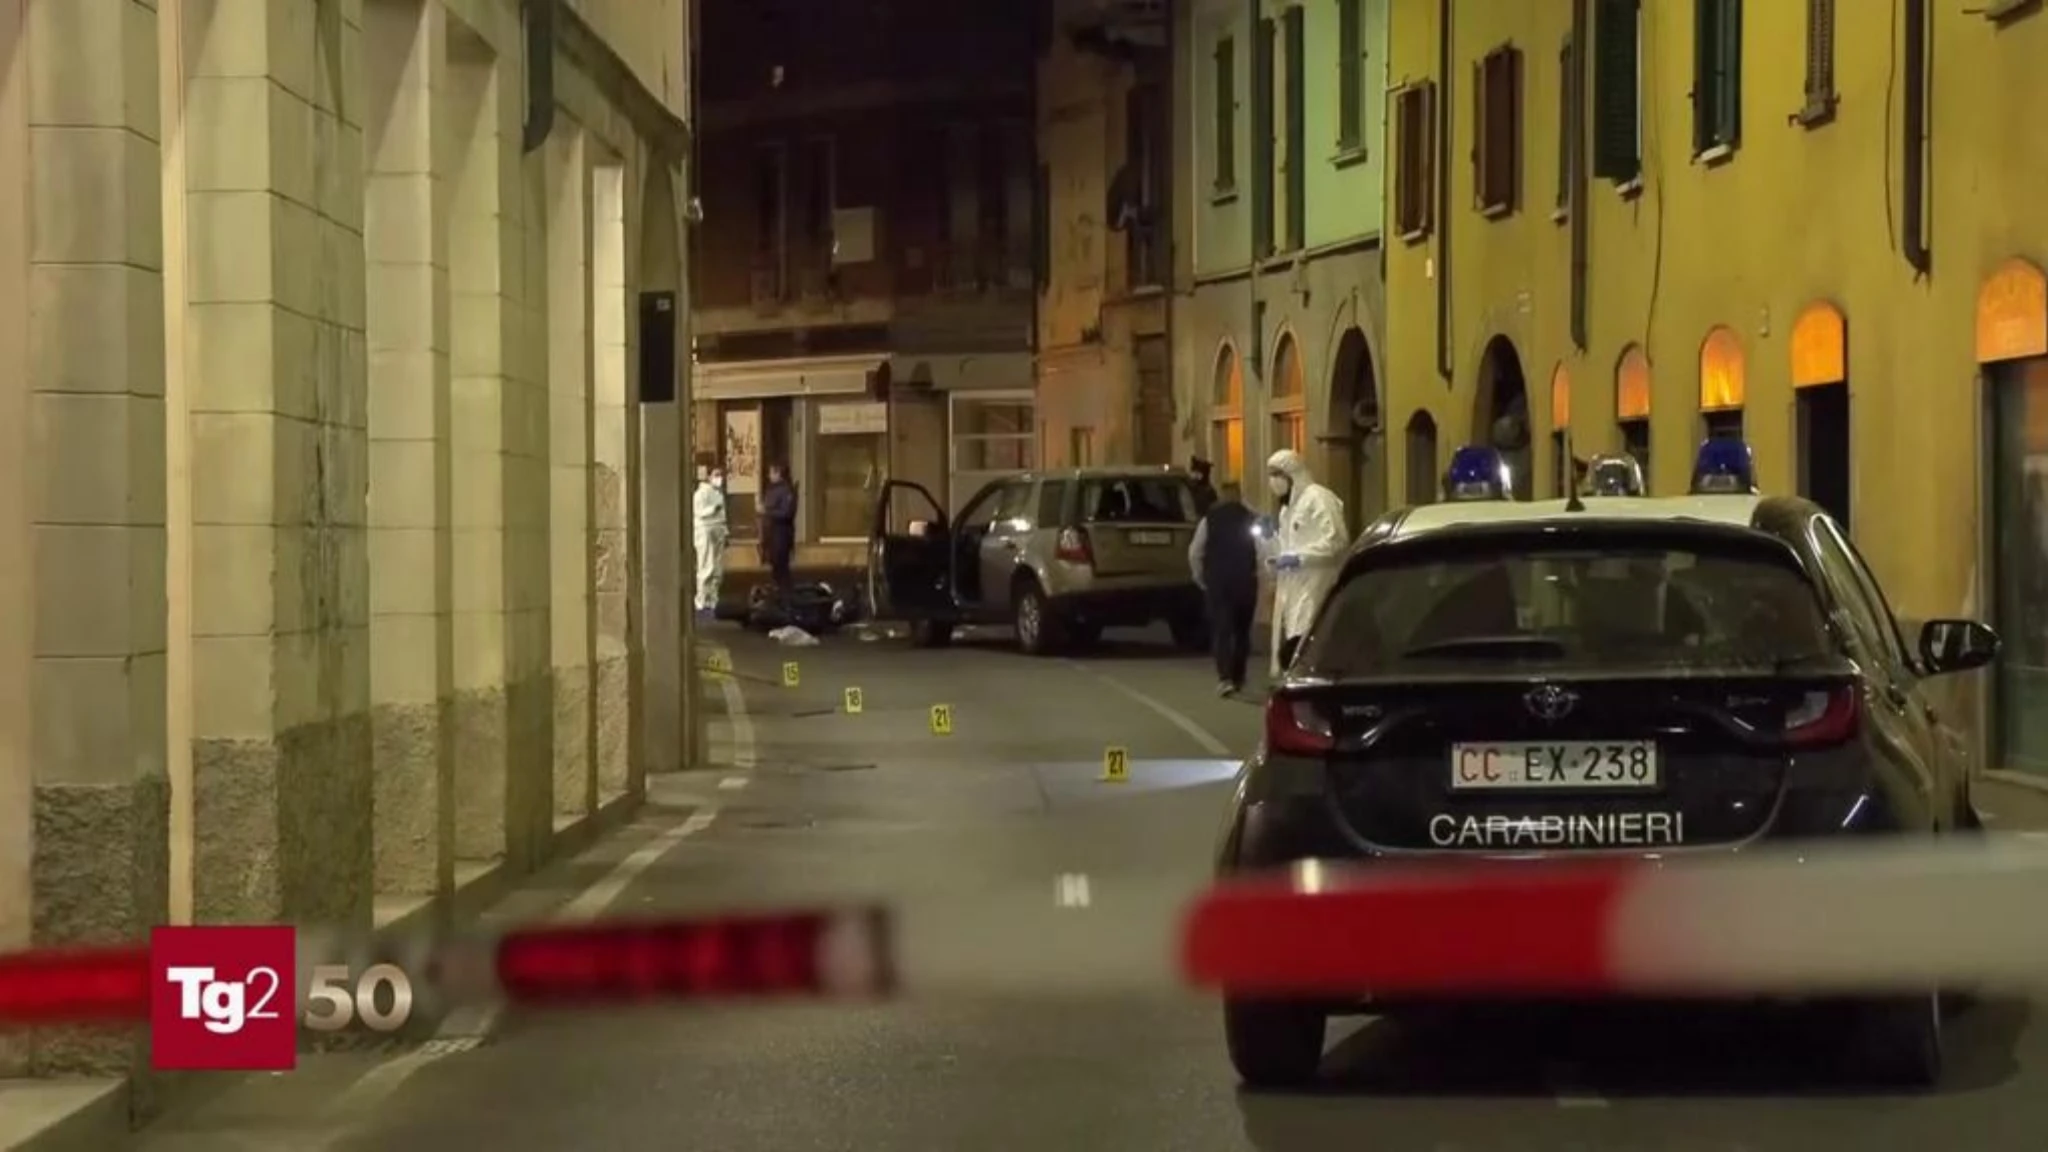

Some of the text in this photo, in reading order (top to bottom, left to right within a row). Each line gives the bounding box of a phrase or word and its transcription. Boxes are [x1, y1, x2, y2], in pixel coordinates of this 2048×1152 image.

[934, 706, 949, 727] 21
[1107, 750, 1124, 776] 27
[1461, 748, 1501, 782] CC
[1428, 811, 1684, 846] CARABINIERI
